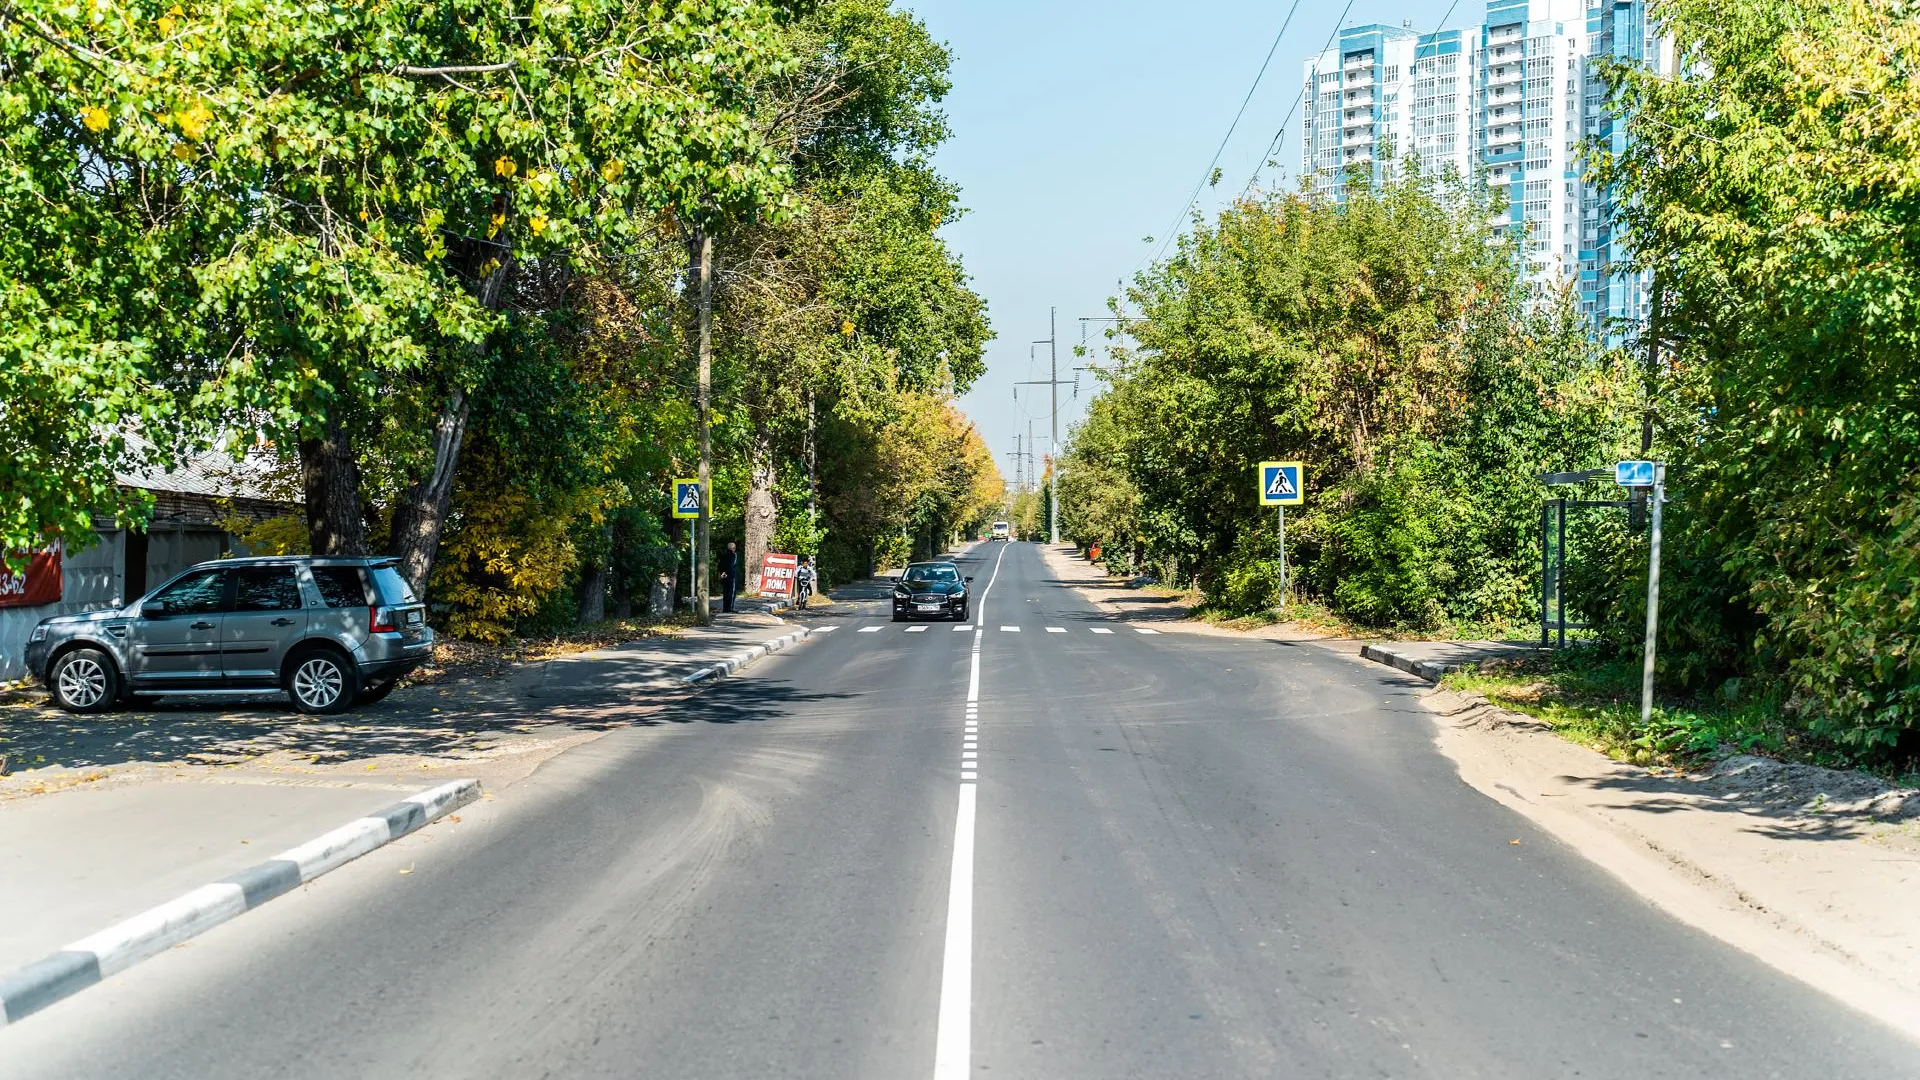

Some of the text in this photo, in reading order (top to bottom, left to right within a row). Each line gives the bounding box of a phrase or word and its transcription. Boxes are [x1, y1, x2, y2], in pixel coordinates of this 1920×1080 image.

[1630, 464, 1639, 478] 1
[764, 566, 792, 578] ПРИЕМ
[0, 573, 26, 595] 3-62
[766, 579, 786, 591] ЛОМА
